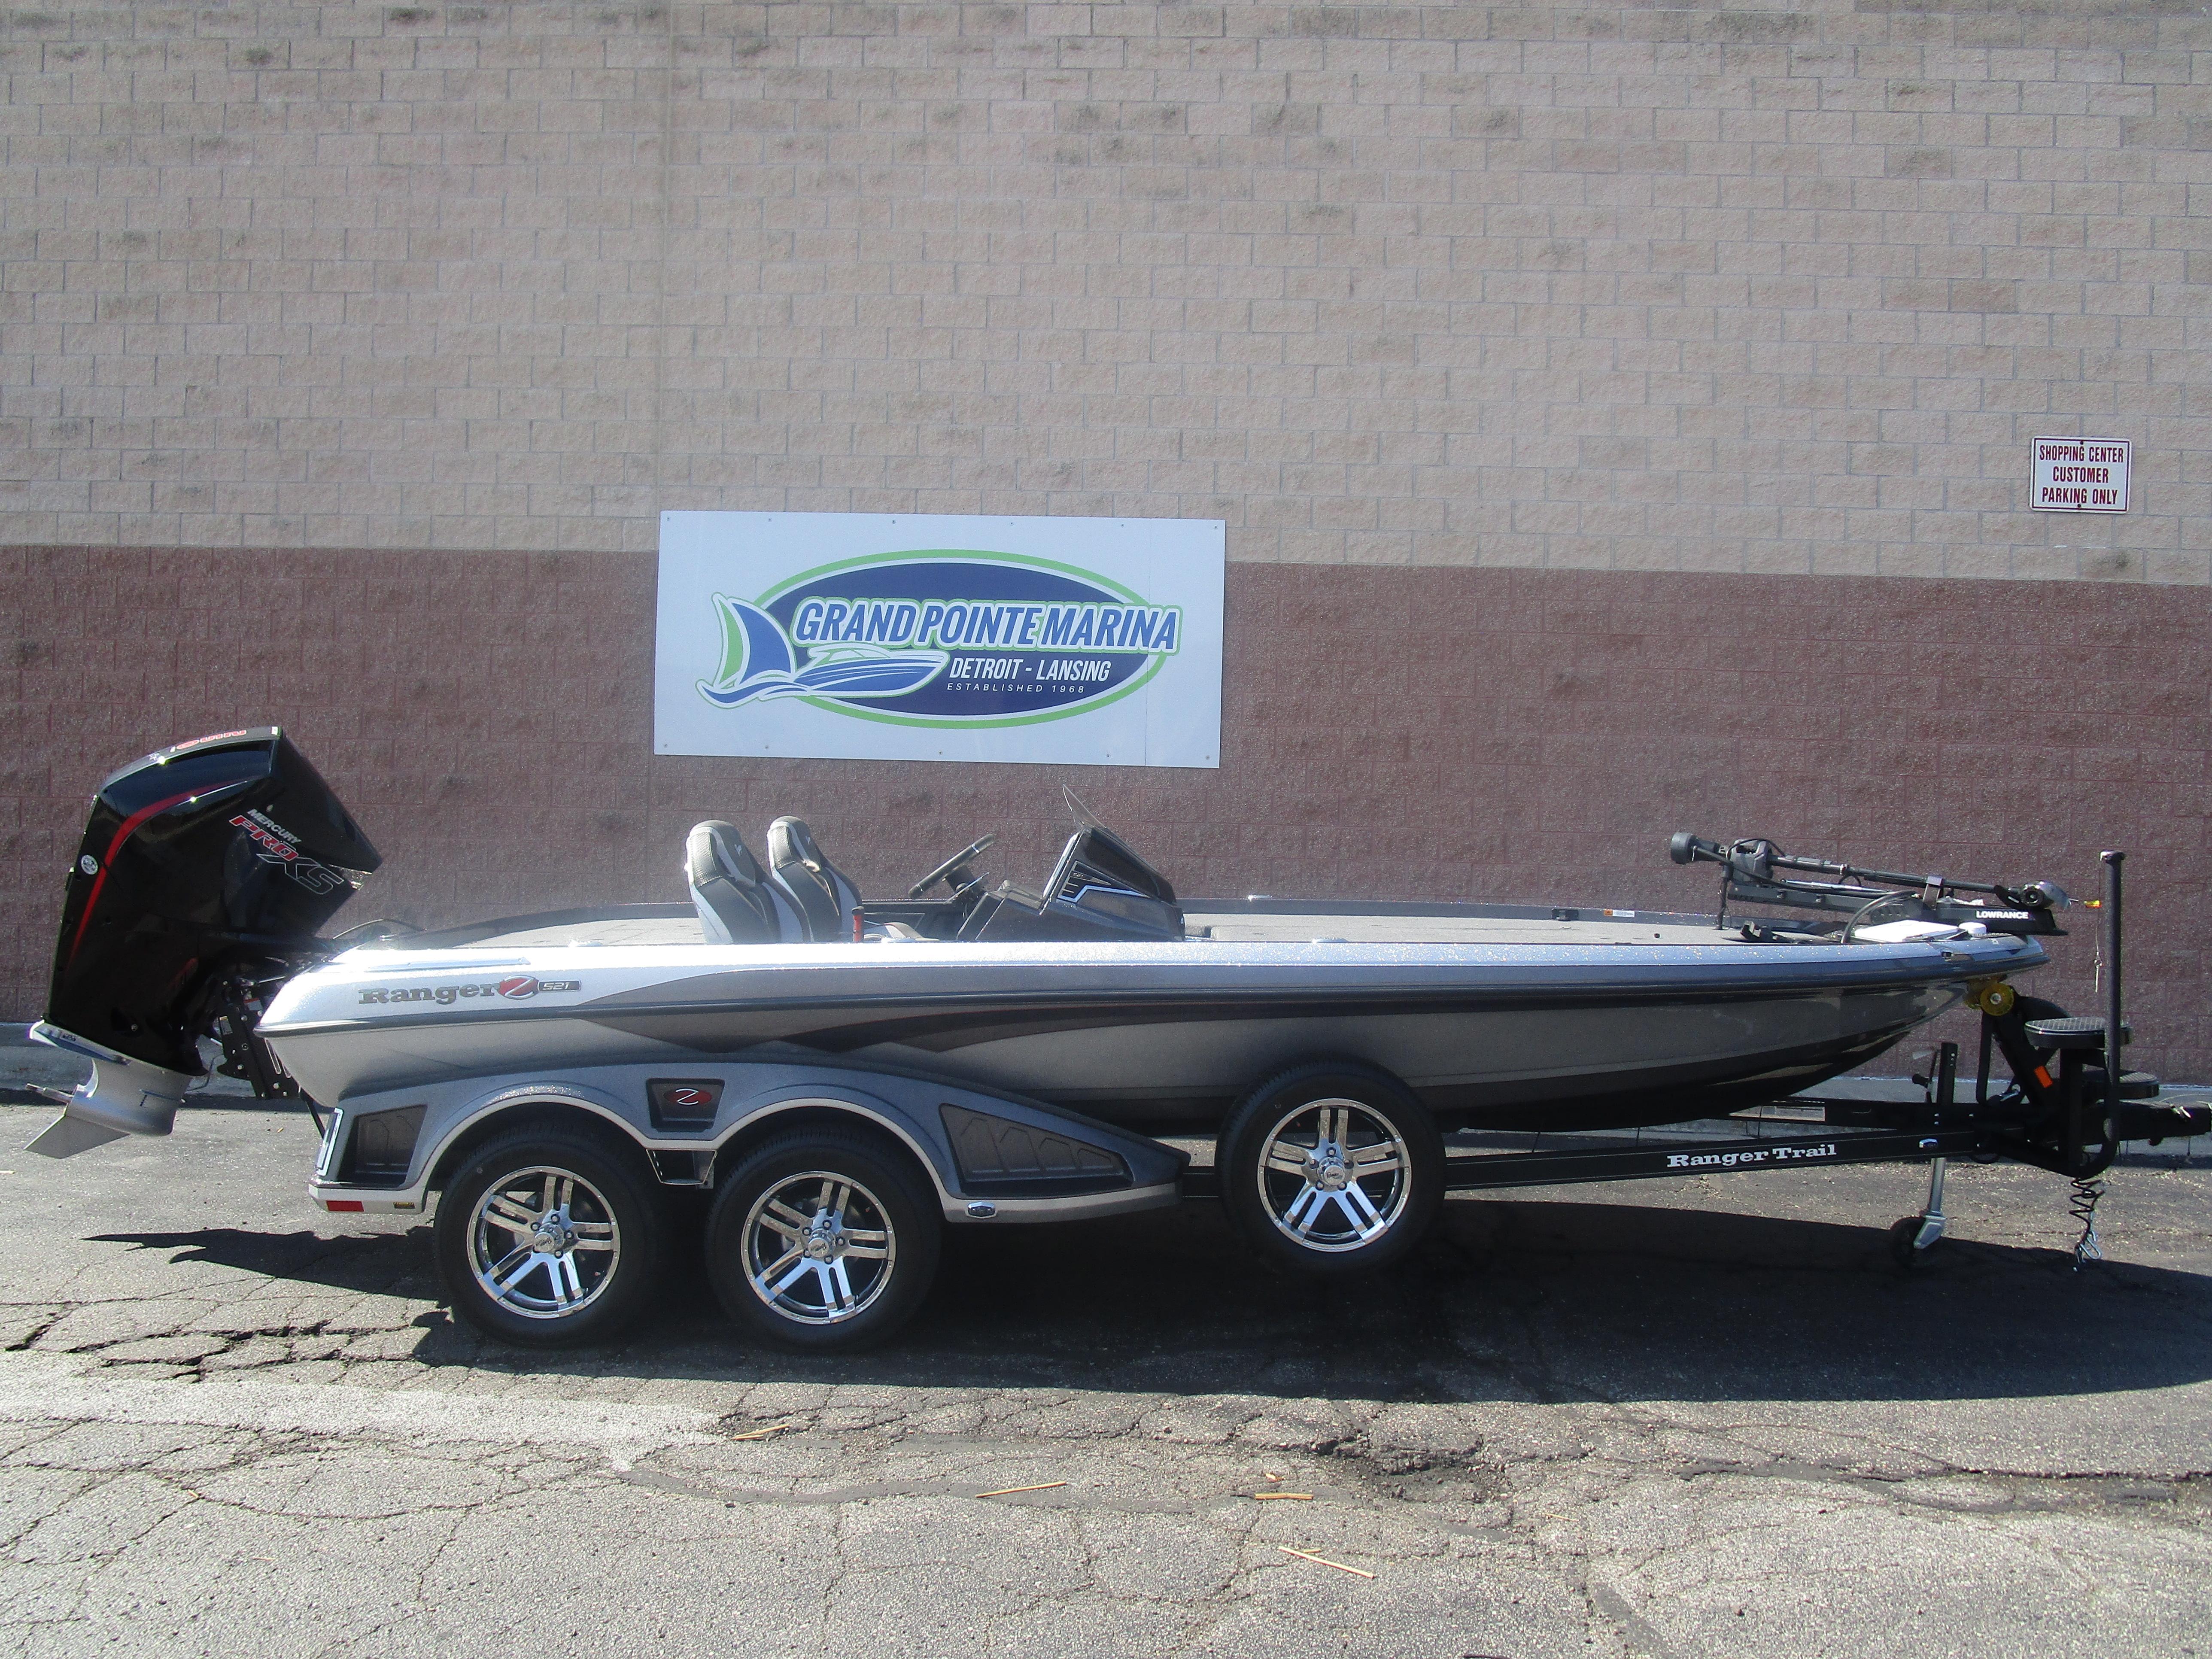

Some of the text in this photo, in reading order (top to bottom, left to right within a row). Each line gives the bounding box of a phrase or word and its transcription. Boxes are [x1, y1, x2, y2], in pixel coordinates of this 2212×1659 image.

[2039, 445, 2124, 462] SHOPPING CENTER
[2053, 466, 2109, 483] CUSTOMER
[2042, 487, 2118, 504] PARKING ONLY
[796, 602, 1177, 649] GRAND POINTE MARINA
[949, 657, 1024, 680] DETROIT
[1036, 659, 1112, 681] LANSING
[947, 683, 1085, 693] ESTABLISHED 1968
[229, 815, 299, 861] PRO
[246, 808, 302, 844] MERCURY
[256, 853, 344, 895] XS
[1976, 910, 2029, 919] LOWRANCE
[359, 983, 501, 1005] Ranger
[542, 981, 571, 991] 521
[1666, 1144, 1837, 1168] Ranger Trail
